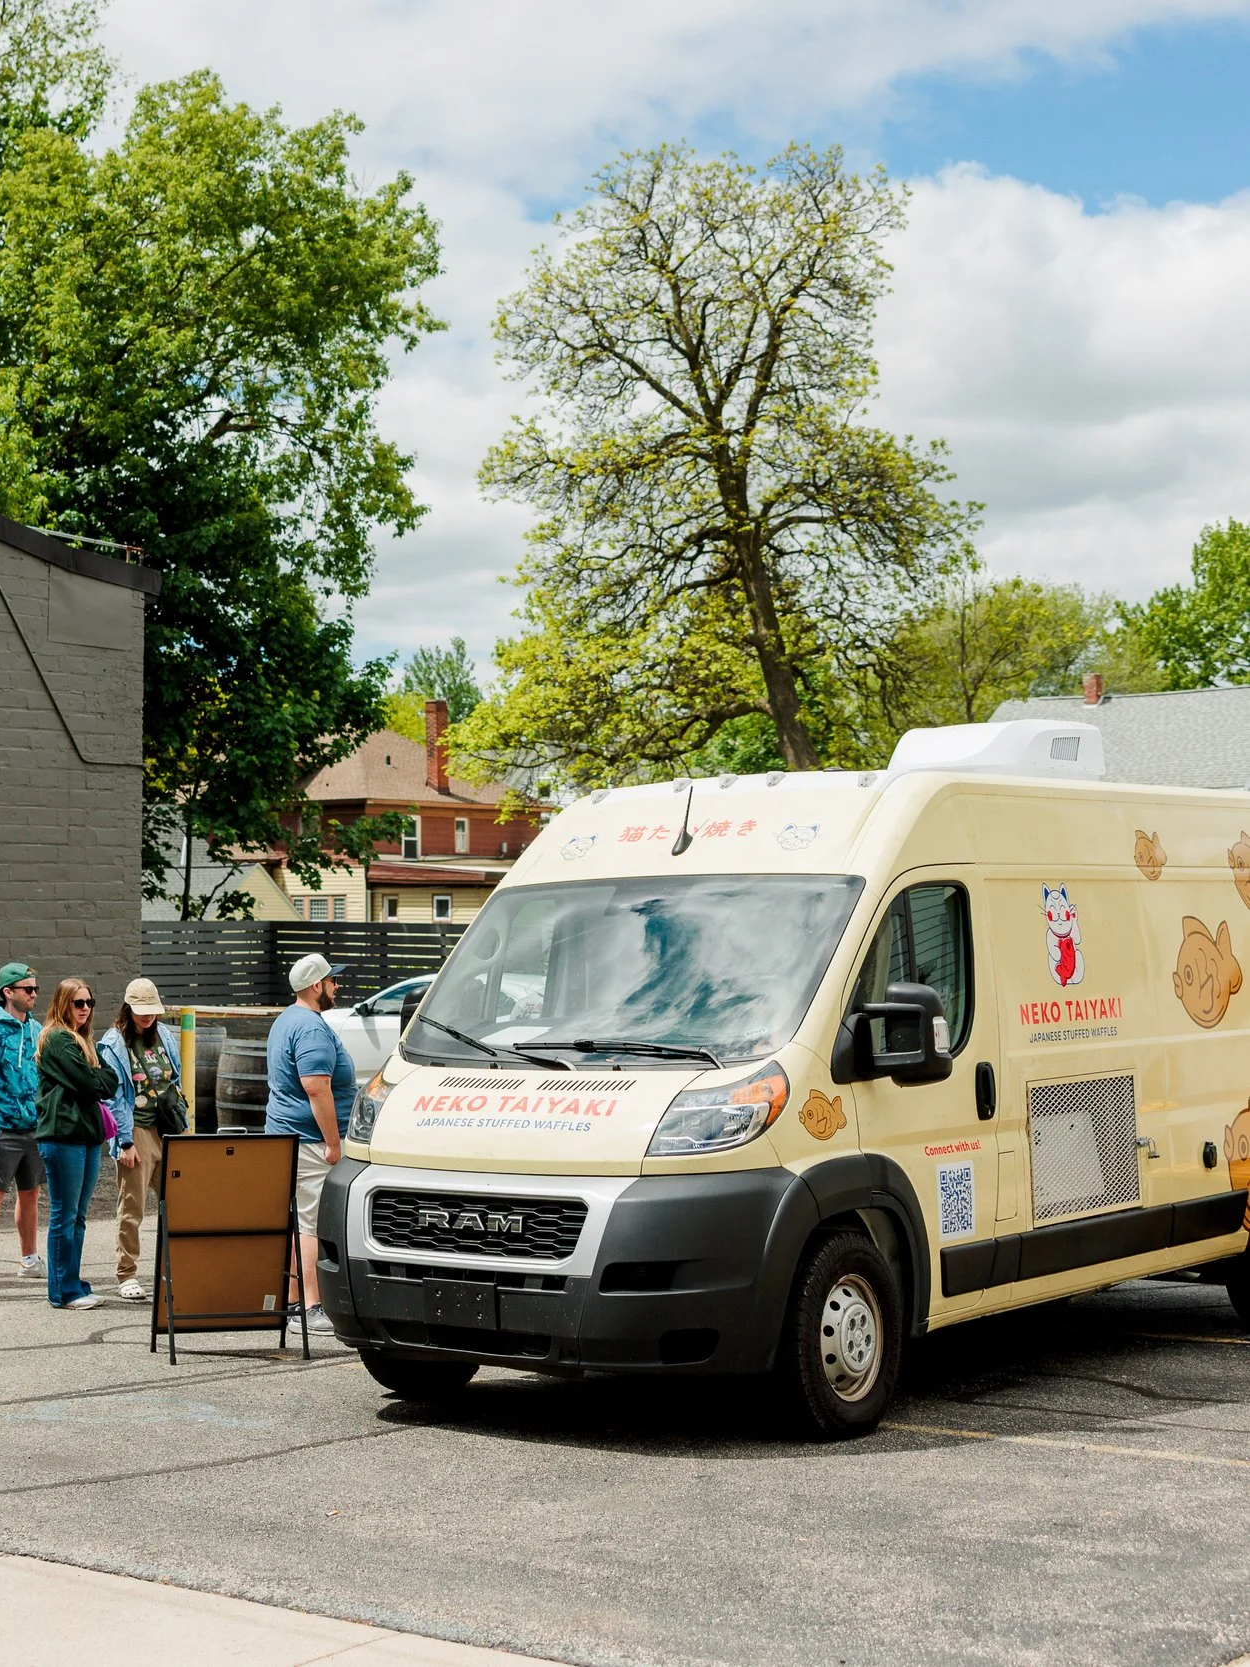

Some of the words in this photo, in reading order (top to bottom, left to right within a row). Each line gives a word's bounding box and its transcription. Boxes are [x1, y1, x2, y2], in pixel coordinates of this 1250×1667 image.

[1019, 1001, 1061, 1026] NEKO
[1064, 997, 1123, 1022] TAIYAKI
[1029, 1031, 1062, 1043] JAPANESE
[1062, 1028, 1090, 1041] STUFFED
[1090, 1026, 1118, 1038] WAFFLES
[412, 1095, 488, 1112] NEKO
[497, 1096, 618, 1117] TAIYAKI
[416, 1117, 474, 1127] JAPANESE
[476, 1117, 532, 1129] STUFFED
[534, 1120, 592, 1132] WAFFLES
[924, 1145, 954, 1156] Connect
[954, 1140, 970, 1153] with
[970, 1139, 981, 1151] us!
[418, 1209, 526, 1233] RAM
